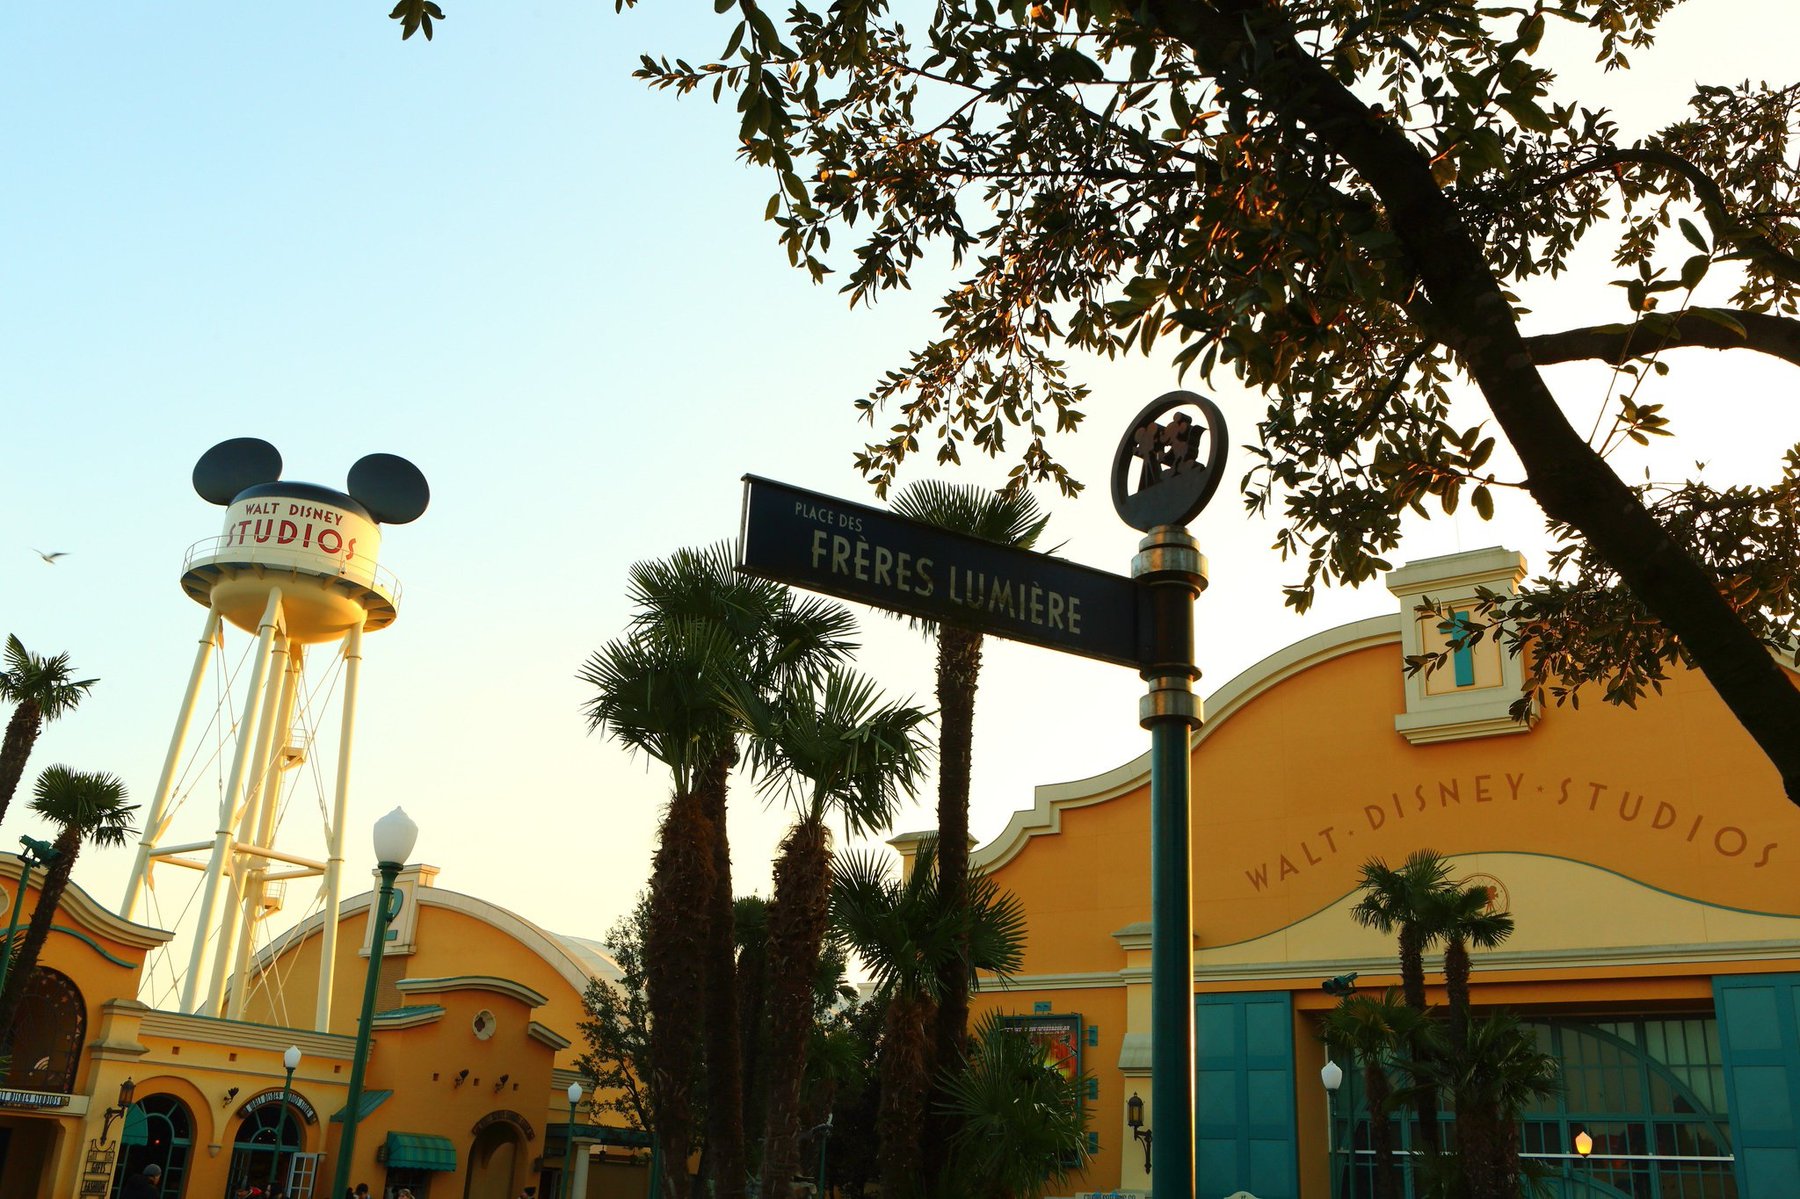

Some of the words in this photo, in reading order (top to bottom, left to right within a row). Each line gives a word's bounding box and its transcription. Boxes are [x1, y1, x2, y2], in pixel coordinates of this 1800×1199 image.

[245, 502, 280, 516] WALT
[289, 503, 344, 526] DISNEY
[795, 502, 834, 525] PLACE
[839, 514, 863, 532] DES
[226, 518, 357, 561] STUDIOS
[811, 529, 934, 598] FRÈRES
[949, 565, 1082, 635] LUMIÈRE
[1244, 826, 1341, 893] WALT
[1363, 772, 1526, 832] DISNEY
[1557, 777, 1779, 868] STUDIOS
